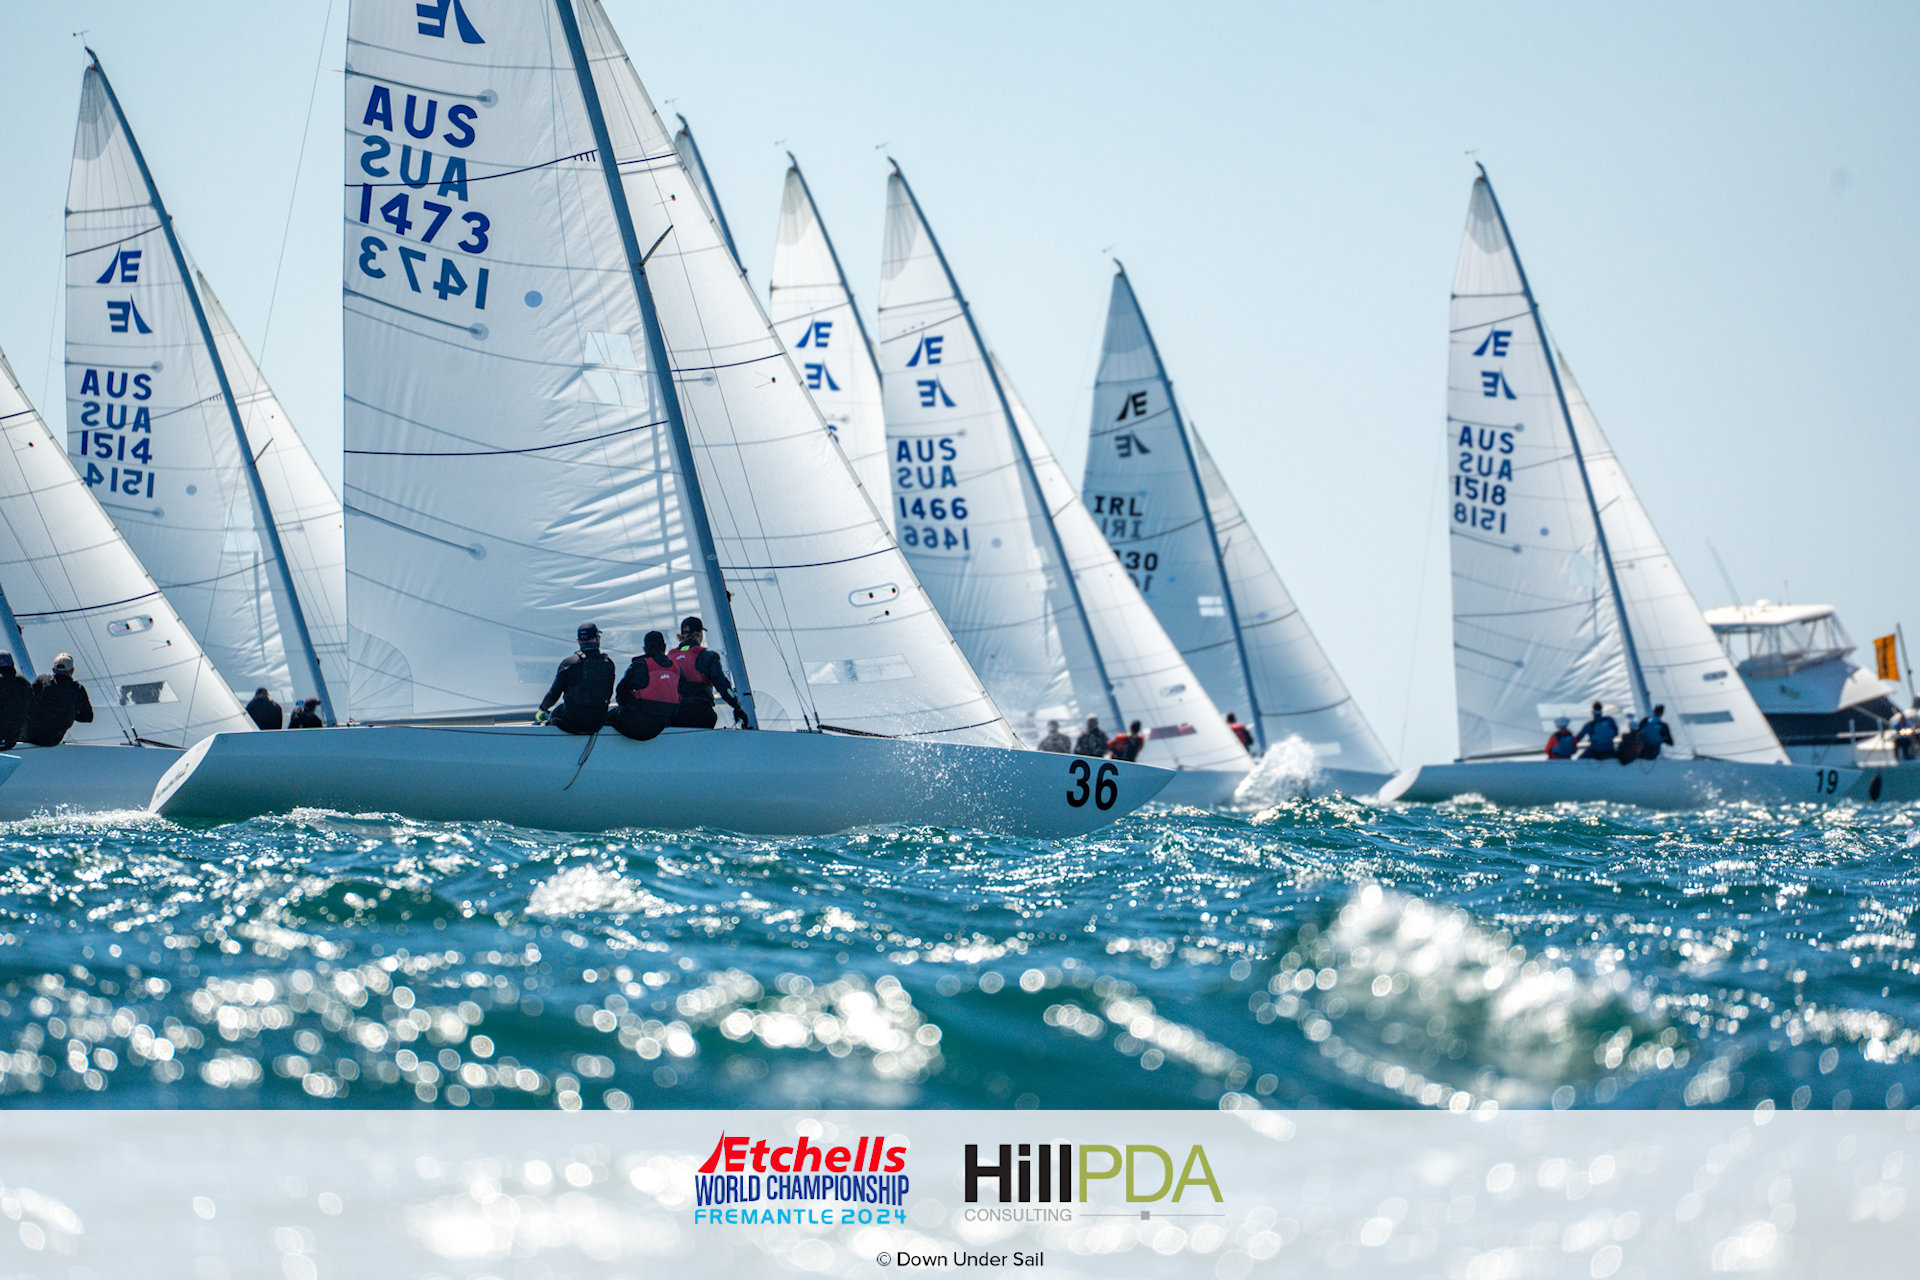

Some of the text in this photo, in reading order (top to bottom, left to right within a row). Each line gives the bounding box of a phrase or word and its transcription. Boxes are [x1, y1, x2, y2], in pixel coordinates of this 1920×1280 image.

[363, 85, 478, 148] AUS
[359, 183, 491, 254] 1473
[80, 368, 152, 401] AUS
[81, 430, 152, 465] 1514
[896, 437, 957, 463] AUS
[1458, 425, 1515, 454] AUS
[1093, 495, 1144, 517] IRL
[1455, 475, 1506, 506] 1518
[899, 496, 968, 521] 1466
[1066, 759, 1119, 811] 36
[1816, 768, 1839, 795] 19
